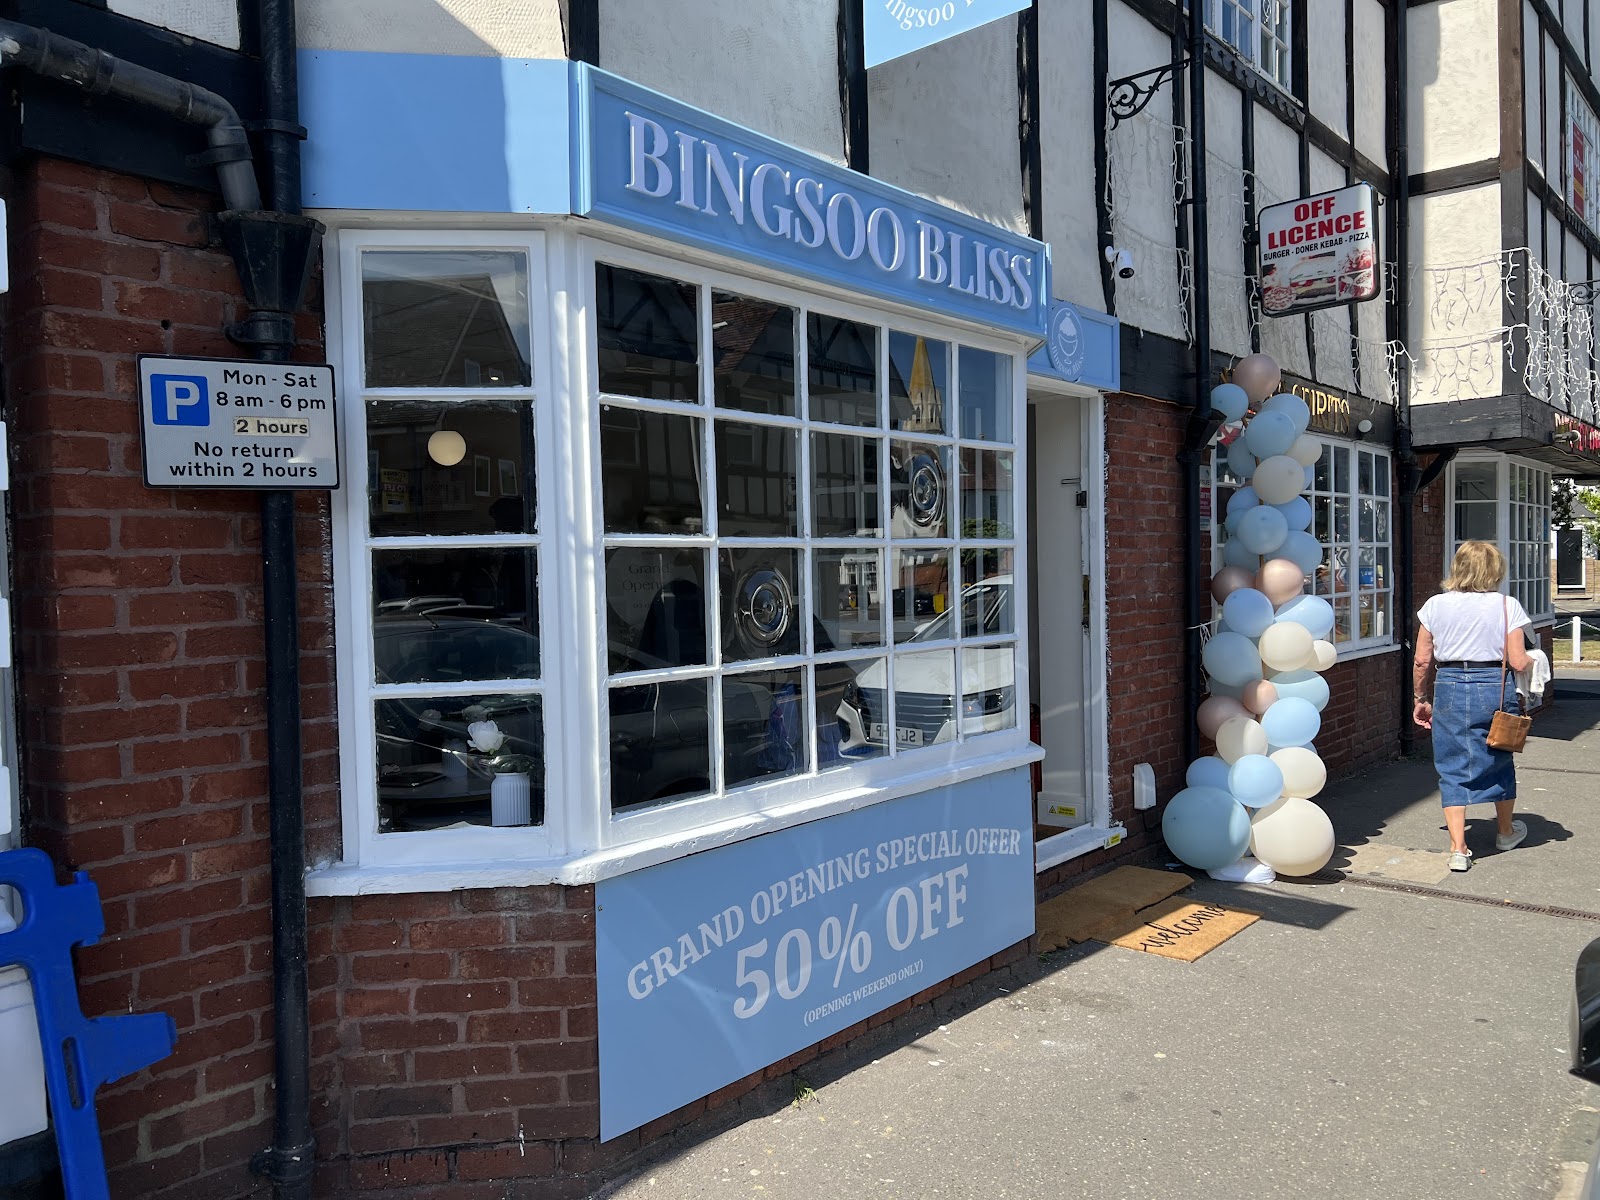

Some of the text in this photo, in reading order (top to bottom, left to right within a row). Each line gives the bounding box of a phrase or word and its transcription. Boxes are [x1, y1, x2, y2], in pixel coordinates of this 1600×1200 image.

[624, 110, 1033, 311] BINGSOO BLISS
[1293, 196, 1336, 222] OFF
[1267, 210, 1366, 250] LICENCE
[1263, 249, 1290, 261] BURGER
[1295, 242, 1319, 254] DONER
[1320, 237, 1343, 249] KEBAB
[1349, 231, 1370, 243] PIZZA
[223, 369, 266, 386] Mon
[283, 372, 317, 388] Sat
[164, 380, 200, 421] P
[216, 391, 229, 406] 8
[234, 396, 264, 407] am
[280, 394, 292, 409] 6
[297, 397, 326, 412] pm
[236, 418, 308, 435] 2 hours
[194, 441, 294, 458] No return
[169, 461, 318, 478] within 2 hours
[622, 580, 662, 593] Open
[627, 828, 1021, 1001] GRAND OPENING SPECIAL OFFER
[1139, 904, 1226, 952] welcome
[733, 863, 969, 1020] 50% OFF
[804, 958, 924, 1027] (OPENING WEEKEND ONLY)
